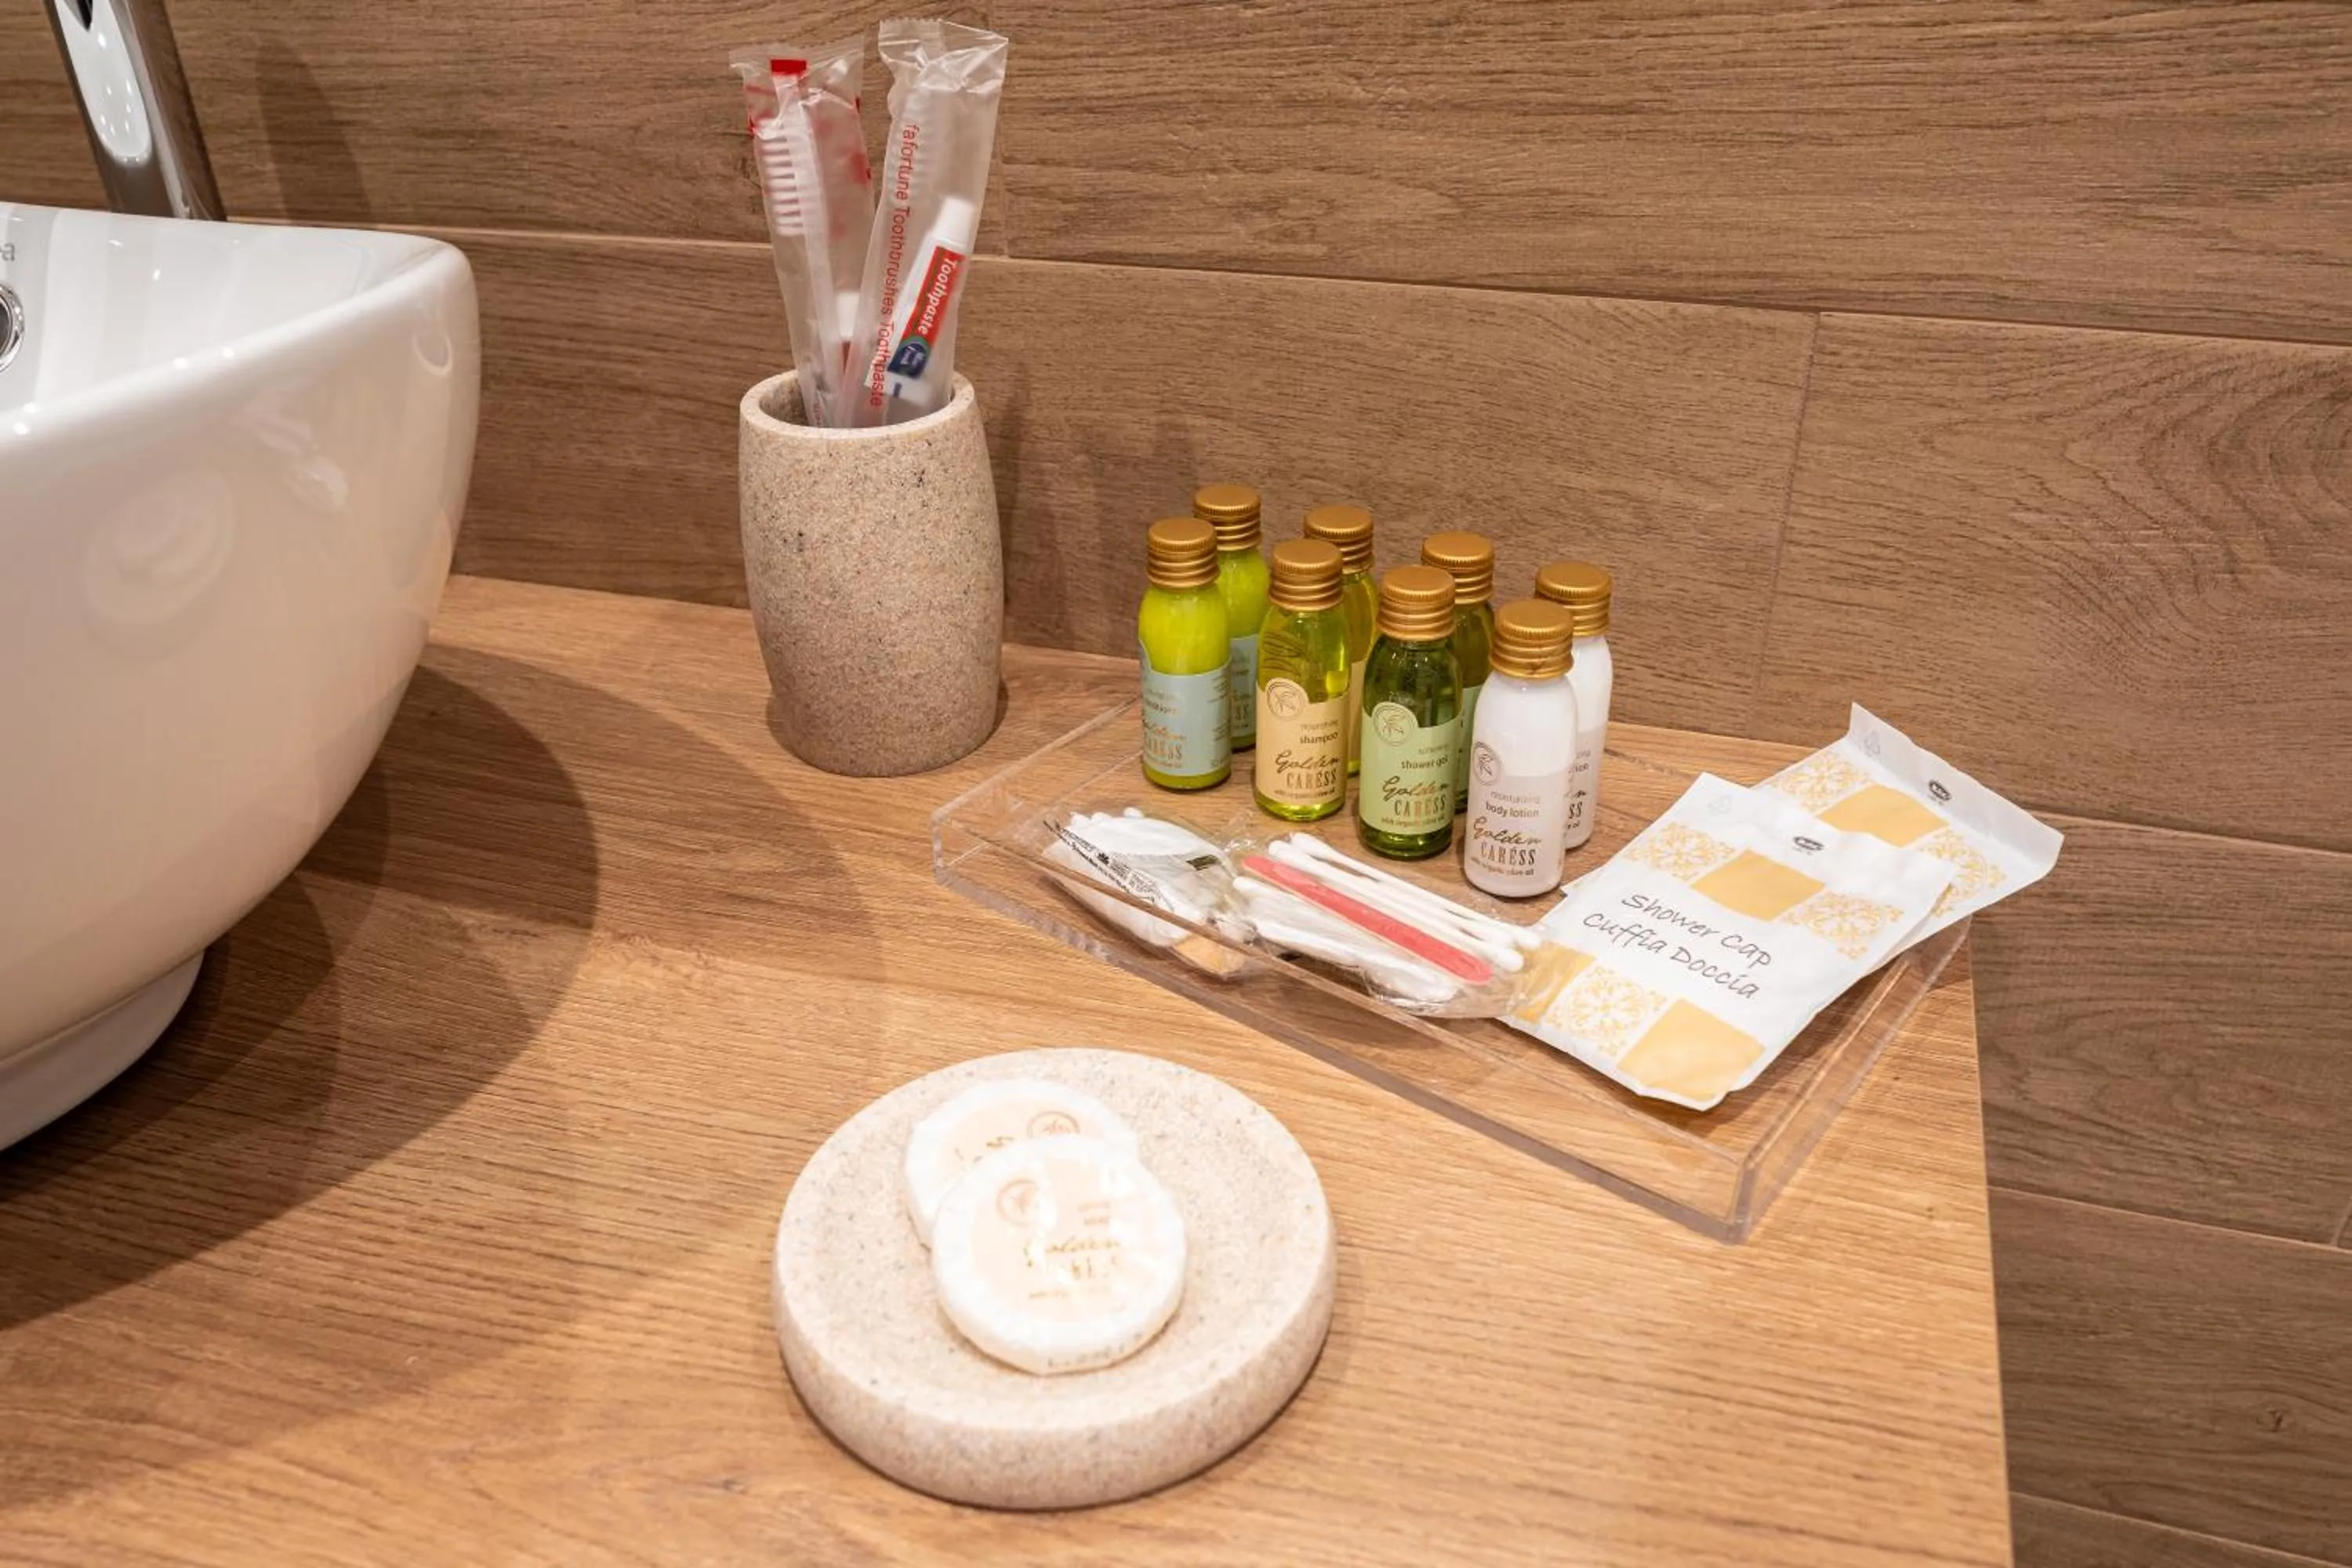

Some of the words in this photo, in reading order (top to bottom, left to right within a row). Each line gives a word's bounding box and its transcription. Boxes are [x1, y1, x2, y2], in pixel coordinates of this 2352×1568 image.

[882, 206, 910, 315] Toothbrushes
[918, 258, 958, 335] Toothpaste
[869, 320, 895, 407] Toothpaste
[1299, 731, 1339, 746] shampoo
[1275, 750, 1339, 775] Golden
[1401, 759, 1435, 770] shower
[1436, 754, 1448, 767] gel
[1287, 768, 1337, 789] CARESS
[1382, 775, 1449, 802] Golden
[1394, 793, 1446, 816] CARESS
[1486, 800, 1507, 818] body
[1509, 807, 1540, 818] lotion
[1473, 815, 1541, 845] Golden
[1621, 894, 1719, 938] Shower
[1721, 934, 1772, 969] Cap
[1583, 913, 1668, 953] Cuffia
[1670, 946, 1760, 999] Doccia
